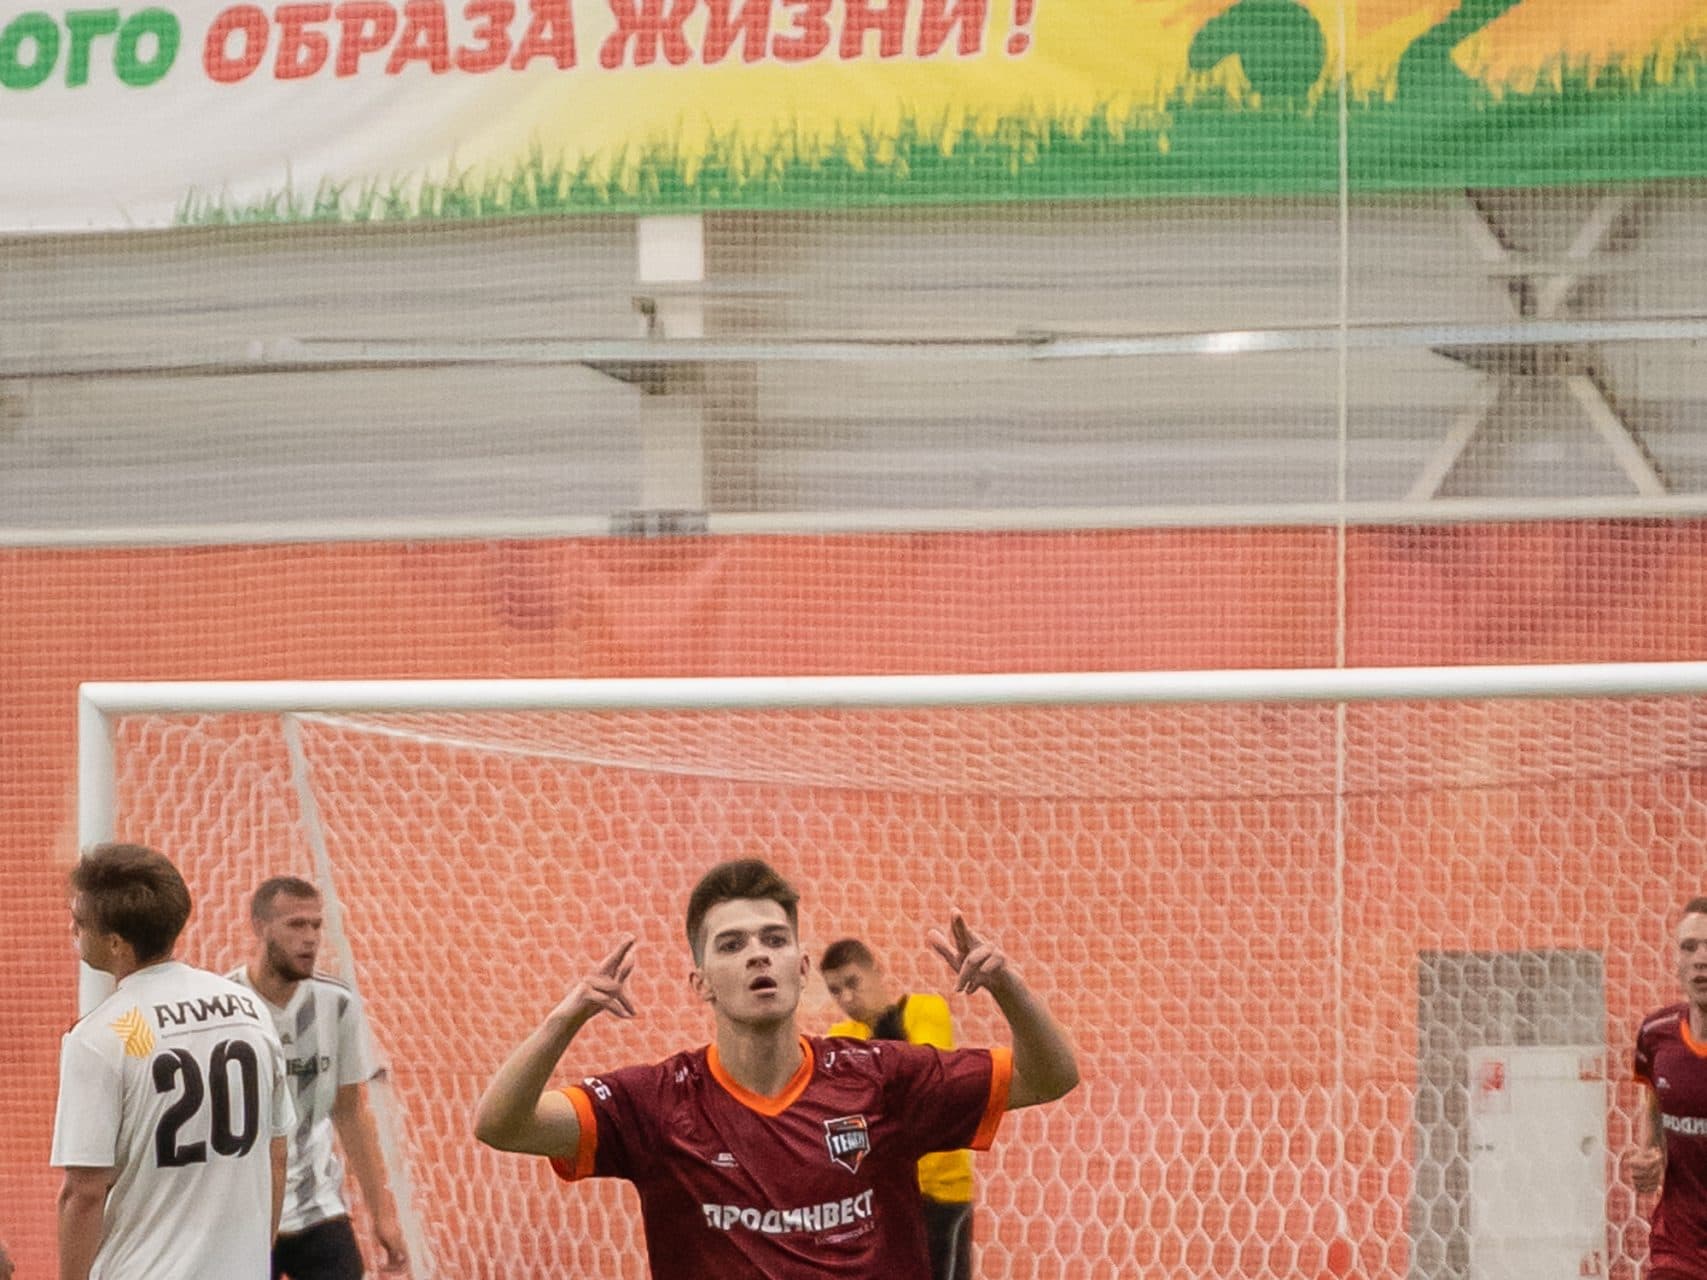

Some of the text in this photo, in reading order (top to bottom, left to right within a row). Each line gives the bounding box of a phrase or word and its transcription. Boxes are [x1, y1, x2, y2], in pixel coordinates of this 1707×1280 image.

[202, 0, 577, 84] ОБРАЗА
[153, 993, 260, 1029] АЛМАЗ
[152, 1038, 260, 1168] 20
[702, 1188, 874, 1233] ПРОДИНВЕСТ
